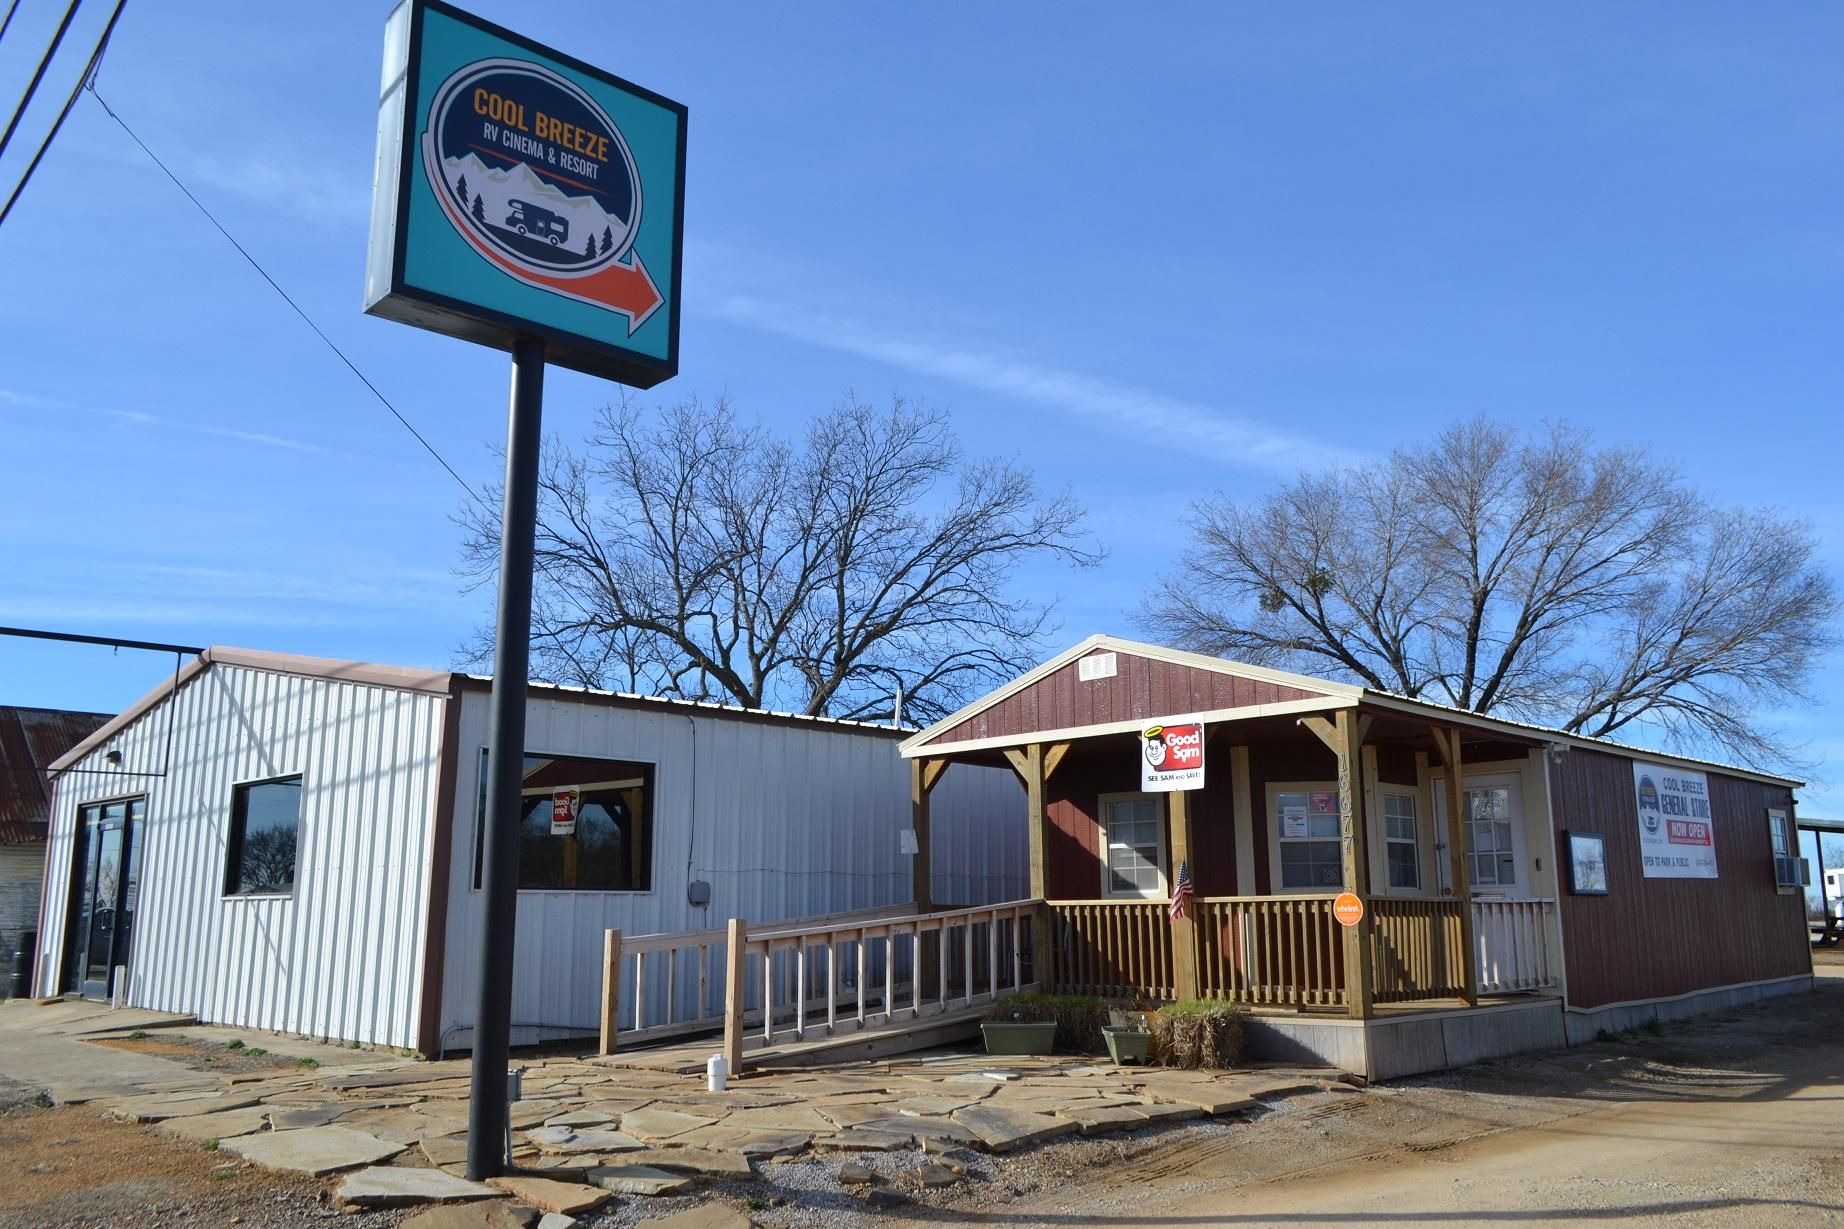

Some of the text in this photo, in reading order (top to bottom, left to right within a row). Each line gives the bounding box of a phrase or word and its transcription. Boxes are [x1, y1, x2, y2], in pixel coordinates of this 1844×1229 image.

[474, 88, 609, 162] COOL BREEZE
[484, 123, 599, 180] RV CINEMA & RESORT
[1166, 730, 1200, 747] Good
[1173, 745, 1200, 763] Sam
[1160, 774, 1175, 782] SAM
[1663, 776, 1704, 795] COOL BREEZE
[1660, 793, 1689, 817] GENERAL
[1691, 797, 1710, 819] STORE
[1671, 821, 1706, 838] NOW OPEN
